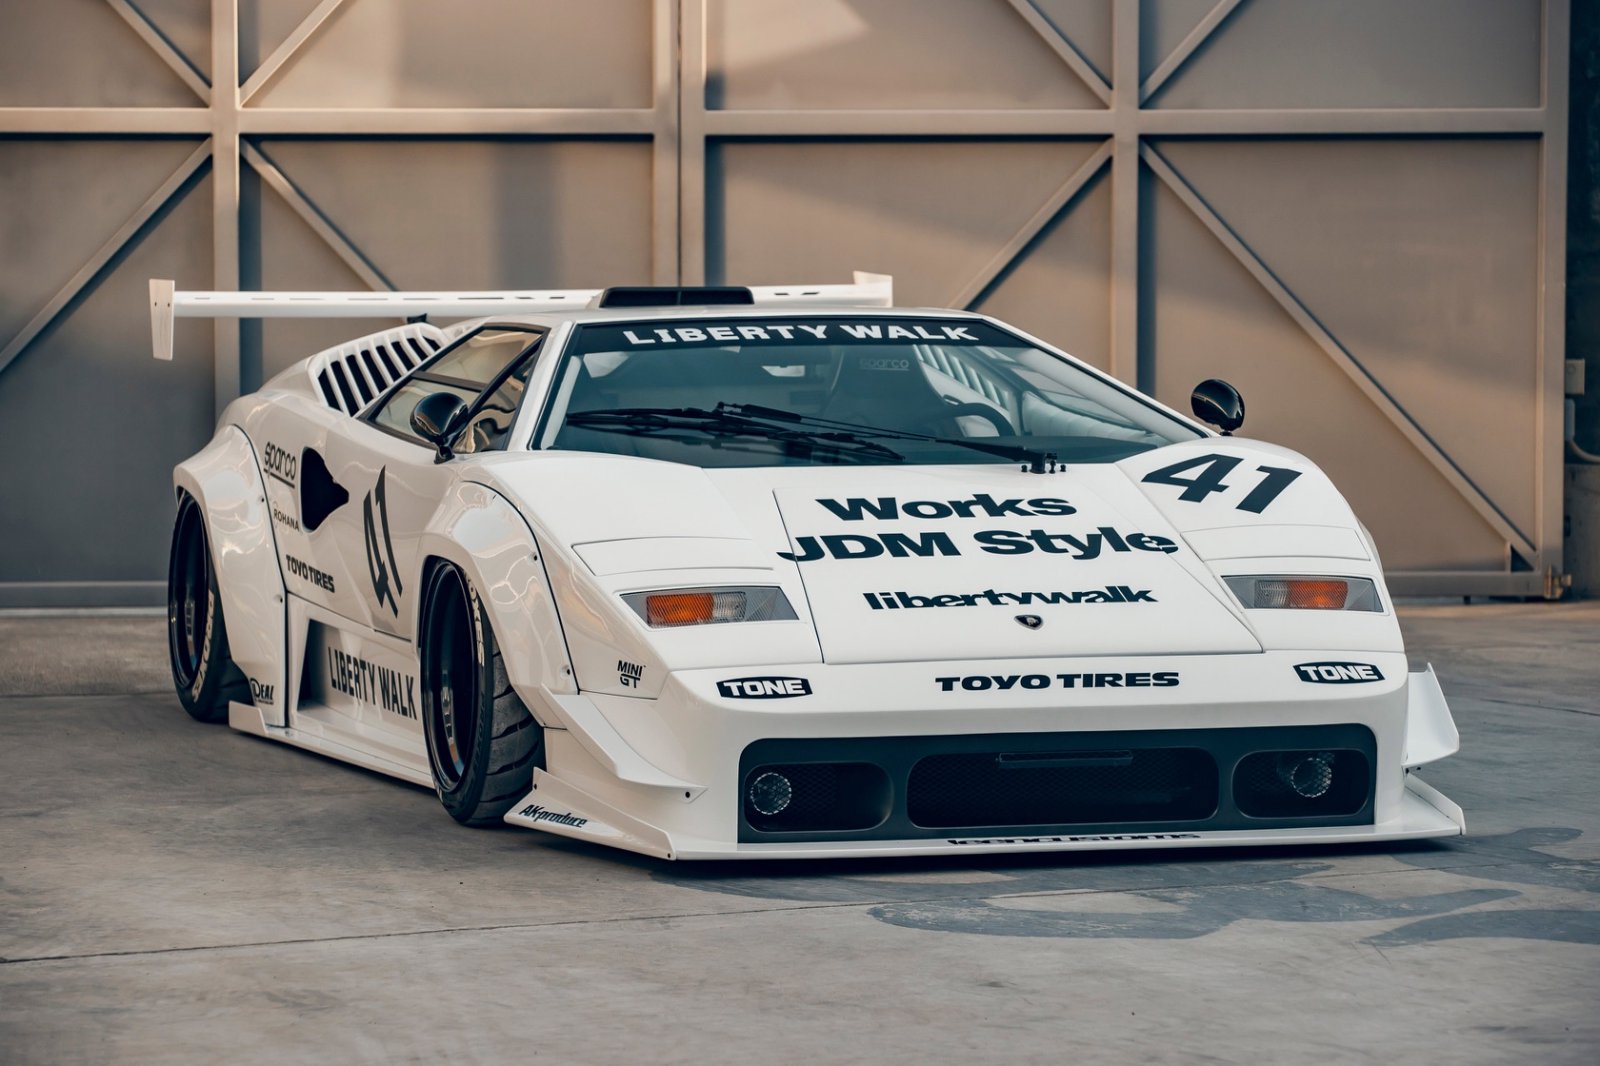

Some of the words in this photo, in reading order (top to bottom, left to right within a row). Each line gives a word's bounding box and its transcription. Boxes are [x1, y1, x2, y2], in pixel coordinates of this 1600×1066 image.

[623, 325, 828, 344] LIBERTY
[840, 324, 980, 341] WALK
[264, 441, 297, 482] sparco
[1141, 452, 1304, 514] 41
[273, 508, 300, 532] ROHANA
[815, 493, 1078, 522] Works
[363, 464, 403, 619] 41
[776, 532, 962, 562] JDM
[972, 527, 1179, 561] Style
[286, 554, 308, 580] TOYO
[308, 566, 335, 593] TIRES
[863, 585, 1159, 611] libertywalk
[617, 660, 643, 677] MINI
[620, 673, 641, 688] GT
[935, 674, 1051, 691] TOYO
[1056, 671, 1180, 689] TIRES
[1299, 665, 1379, 681] TONE
[328, 646, 376, 705] LIBERTY
[378, 666, 417, 721] WALK
[722, 679, 806, 697] TONE
